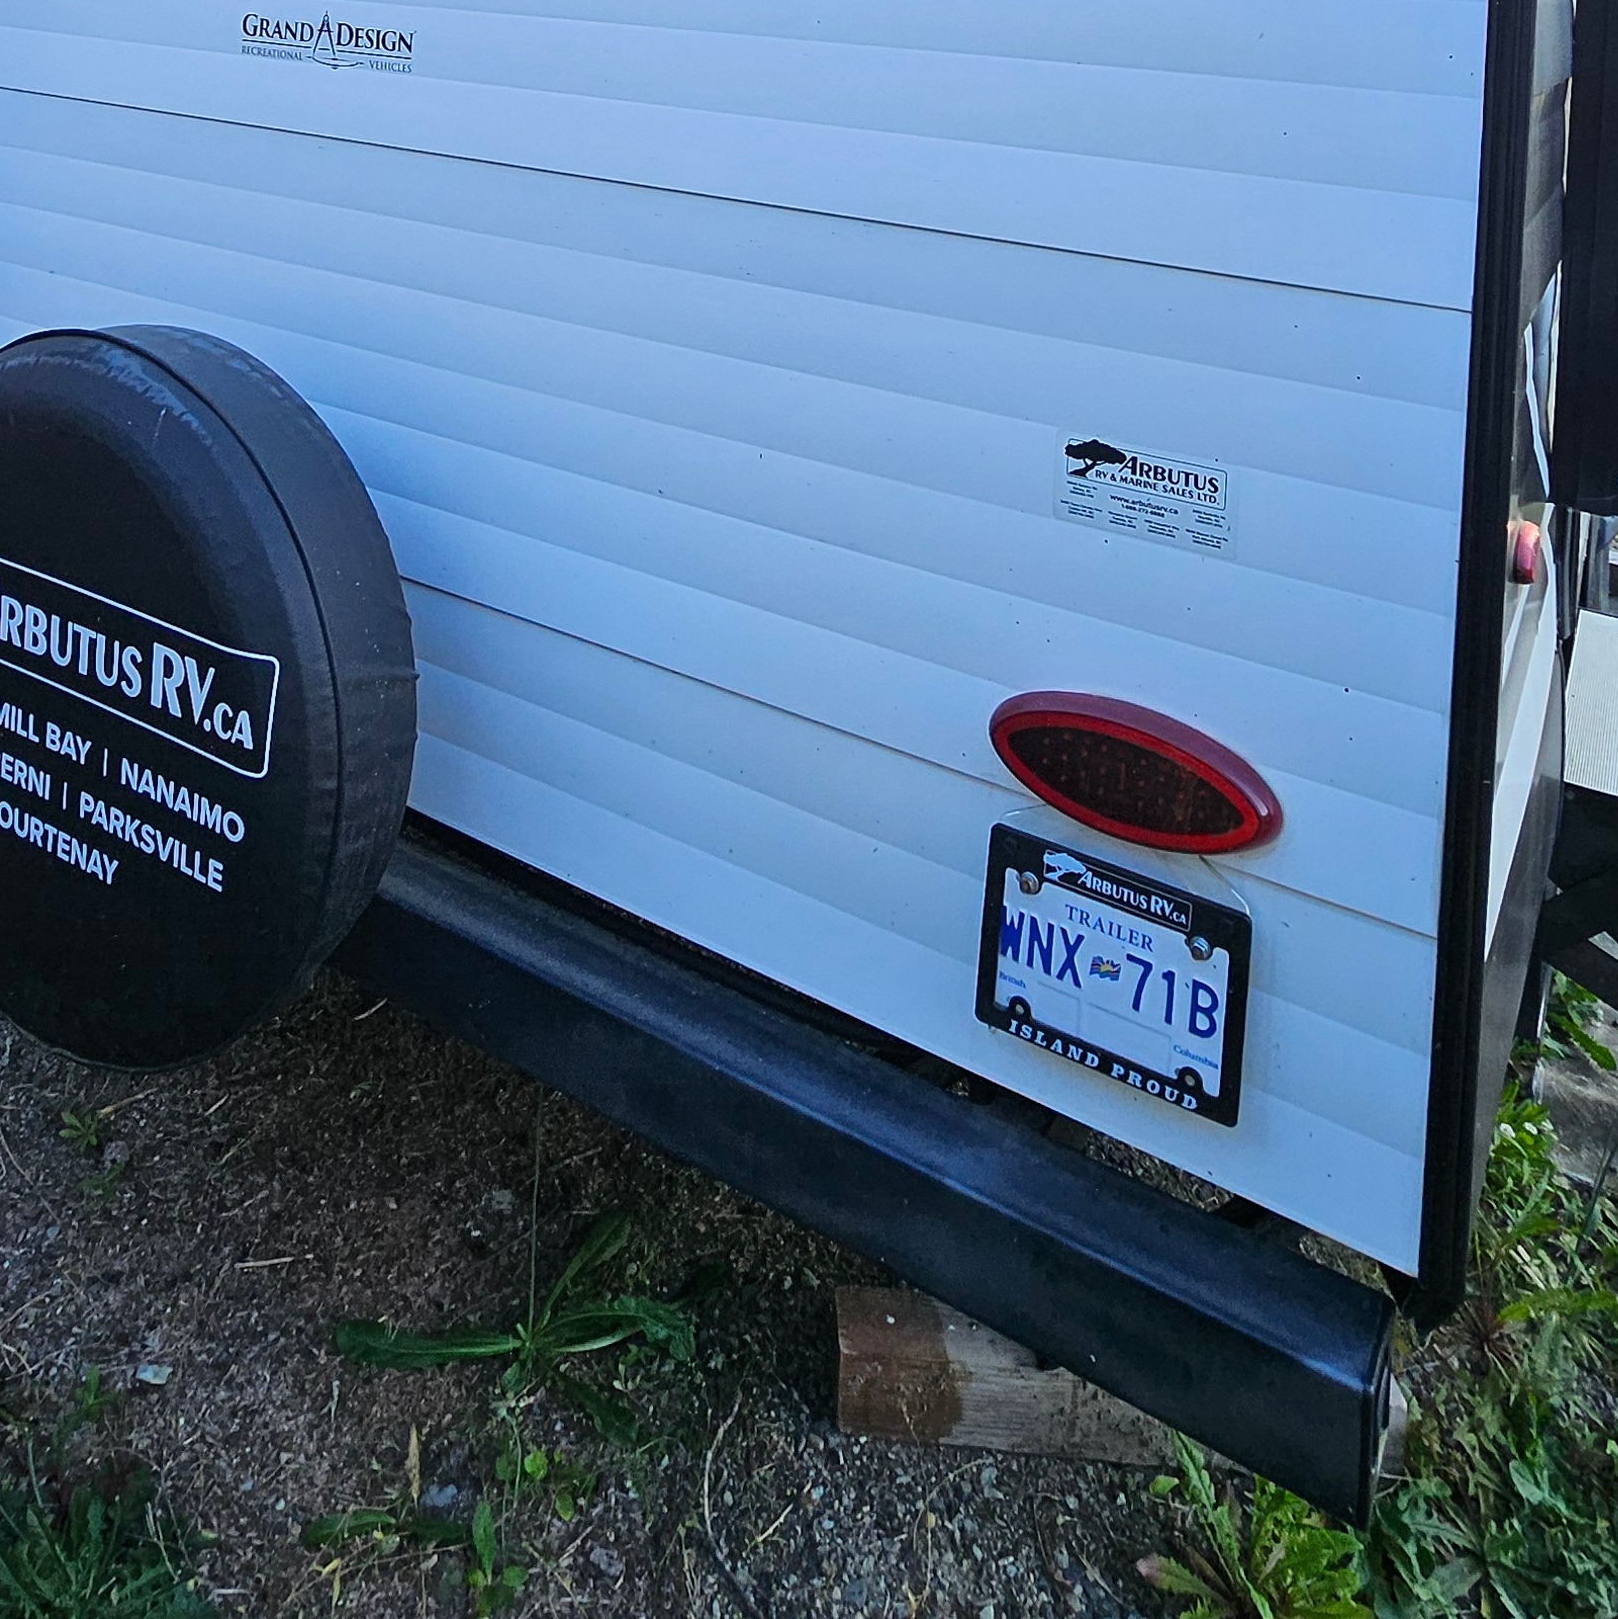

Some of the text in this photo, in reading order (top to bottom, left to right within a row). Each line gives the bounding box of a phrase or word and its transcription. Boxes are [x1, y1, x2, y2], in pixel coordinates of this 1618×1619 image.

[242, 13, 413, 53] GRAND DESIGN
[241, 45, 413, 73] RECREATIONAL VEHICLES
[1095, 469, 1220, 506] RV & MARINE SALES LTD.
[1118, 456, 1219, 494] ARBUTUS
[46, 721, 92, 765] BAY
[121, 757, 245, 843] NANAIMO
[79, 790, 223, 892] PARKSVILLE
[1078, 870, 1147, 910] ARBUTUS
[1065, 903, 1154, 953] TRAILER
[1008, 1018, 1198, 1111] ISLAND PROUD
[1173, 1044, 1219, 1070] Columbia
